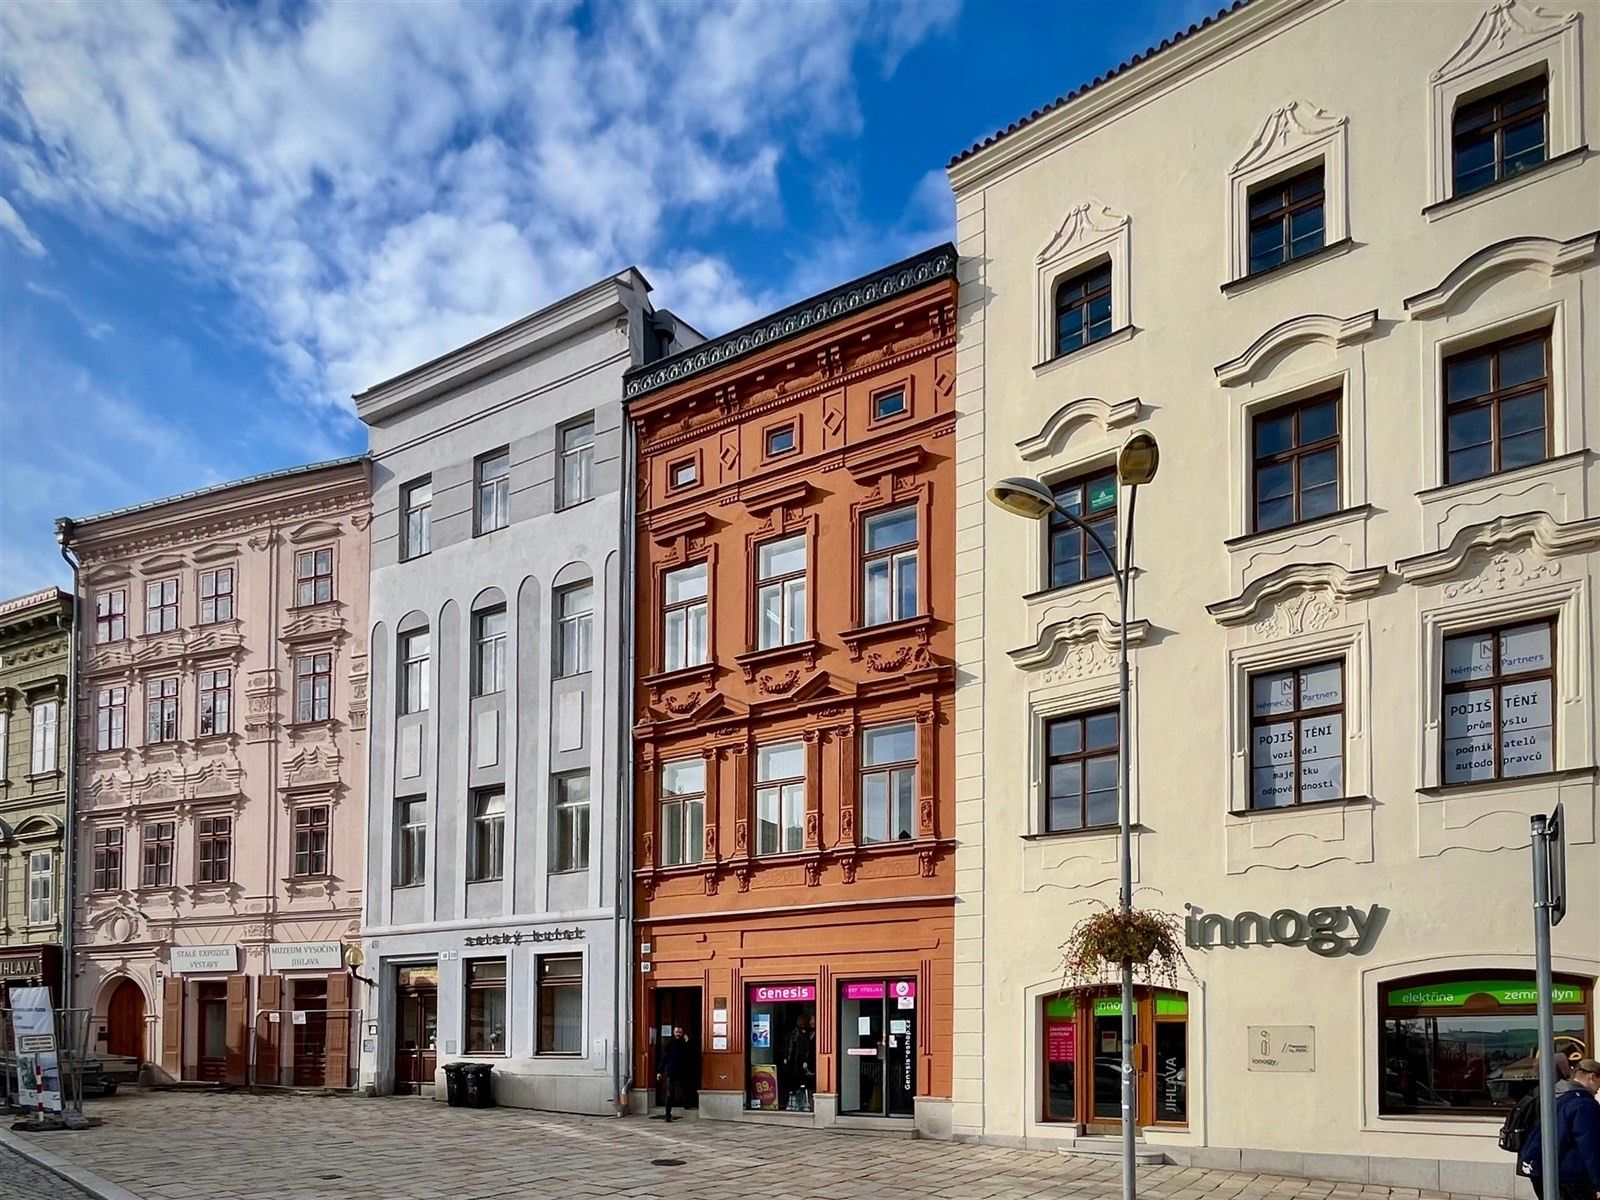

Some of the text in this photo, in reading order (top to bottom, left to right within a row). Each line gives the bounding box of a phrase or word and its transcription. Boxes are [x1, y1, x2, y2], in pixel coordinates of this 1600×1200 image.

[1501, 654, 1544, 666] Partners
[1302, 690, 1338, 702] Partners
[1184, 902, 1384, 957] innogy
[199, 949, 230, 957] EXPOZICE
[271, 945, 339, 954] MUZEUM VYSOČINY
[291, 959, 319, 967] JIHLAVA
[758, 986, 809, 999] Genesis
[1402, 991, 1454, 1002] elektřina
[1165, 1057, 1177, 1112] JIHLAVA
